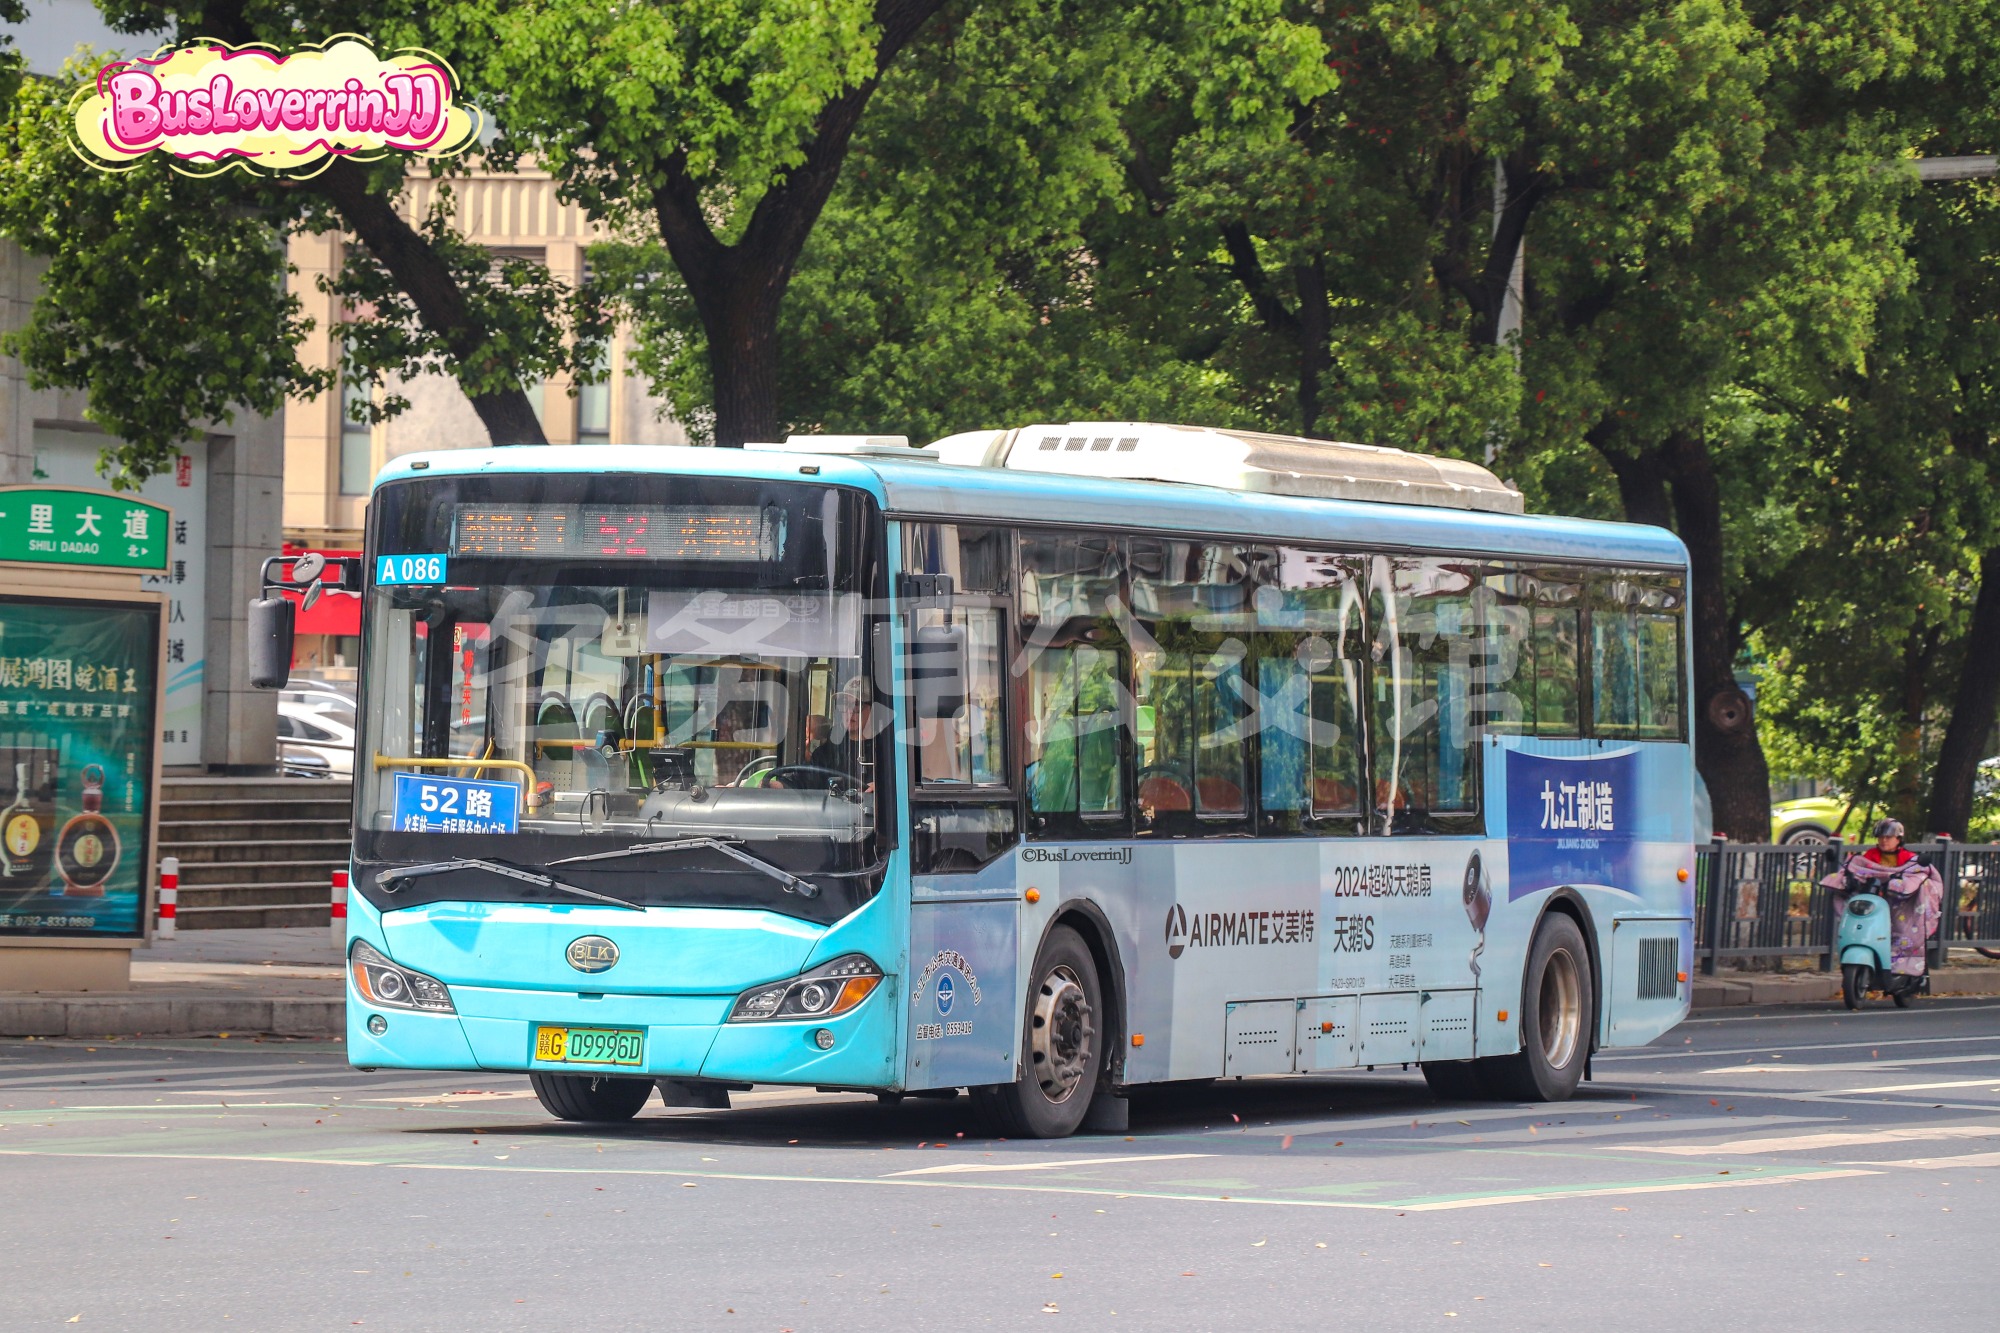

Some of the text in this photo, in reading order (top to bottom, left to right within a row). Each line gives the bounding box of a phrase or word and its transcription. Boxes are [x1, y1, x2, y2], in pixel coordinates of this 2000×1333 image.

[0, 504, 149, 539] 里大道
[29, 540, 99, 554] SHILI DADAO
[128, 545, 139, 557] 北
[461, 650, 475, 725] 防止夹伤
[1540, 780, 1614, 831] 九江制造
[1335, 863, 1432, 897] 2024超级天鹅扇
[1190, 909, 1314, 947] AIRMATE 艾美特
[1333, 914, 1375, 953] 天鹅S
[574, 945, 609, 960] BLK
[912, 949, 981, 1006] 九江市公共交通集团公司
